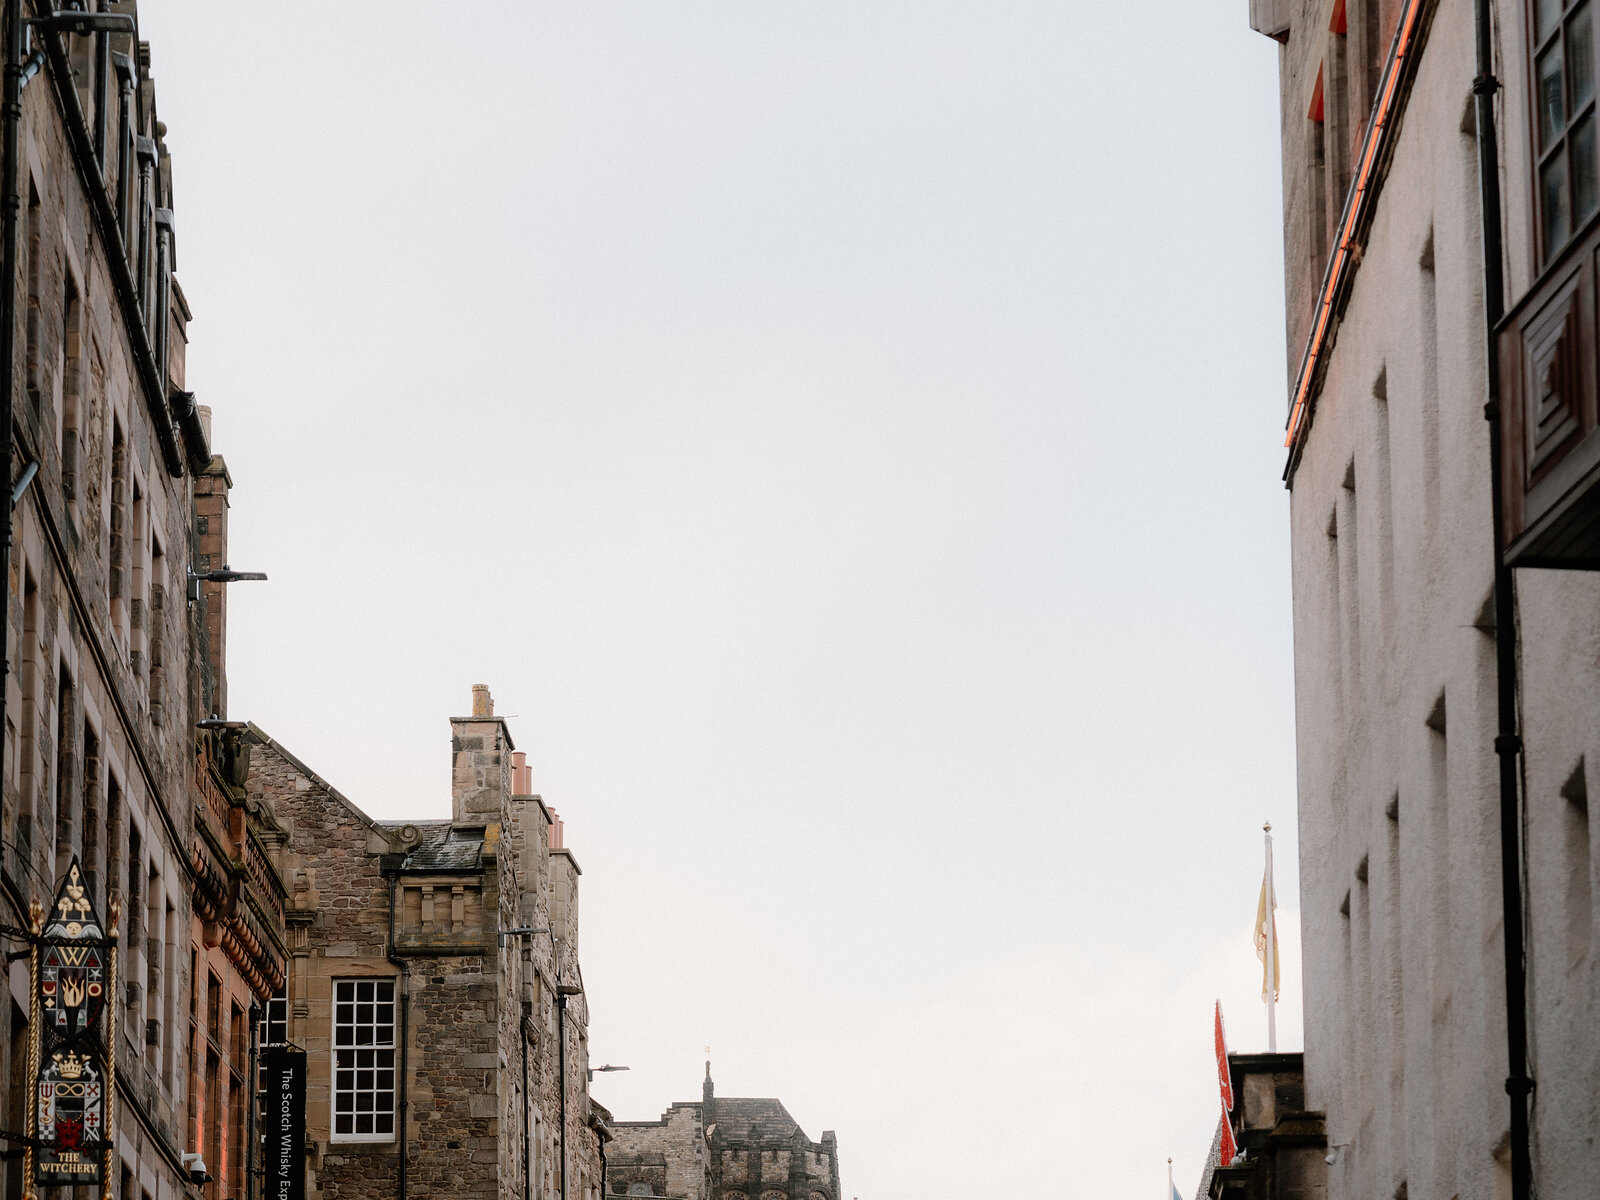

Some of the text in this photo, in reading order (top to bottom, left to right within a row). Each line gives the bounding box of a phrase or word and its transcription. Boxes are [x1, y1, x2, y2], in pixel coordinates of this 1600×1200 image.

[57, 946, 88, 966] W
[282, 1068, 293, 1090] The
[281, 1093, 293, 1131] Scotch
[57, 1152, 80, 1163] THE
[279, 1134, 292, 1178] Whisky
[40, 1162, 98, 1174] WITCHERY
